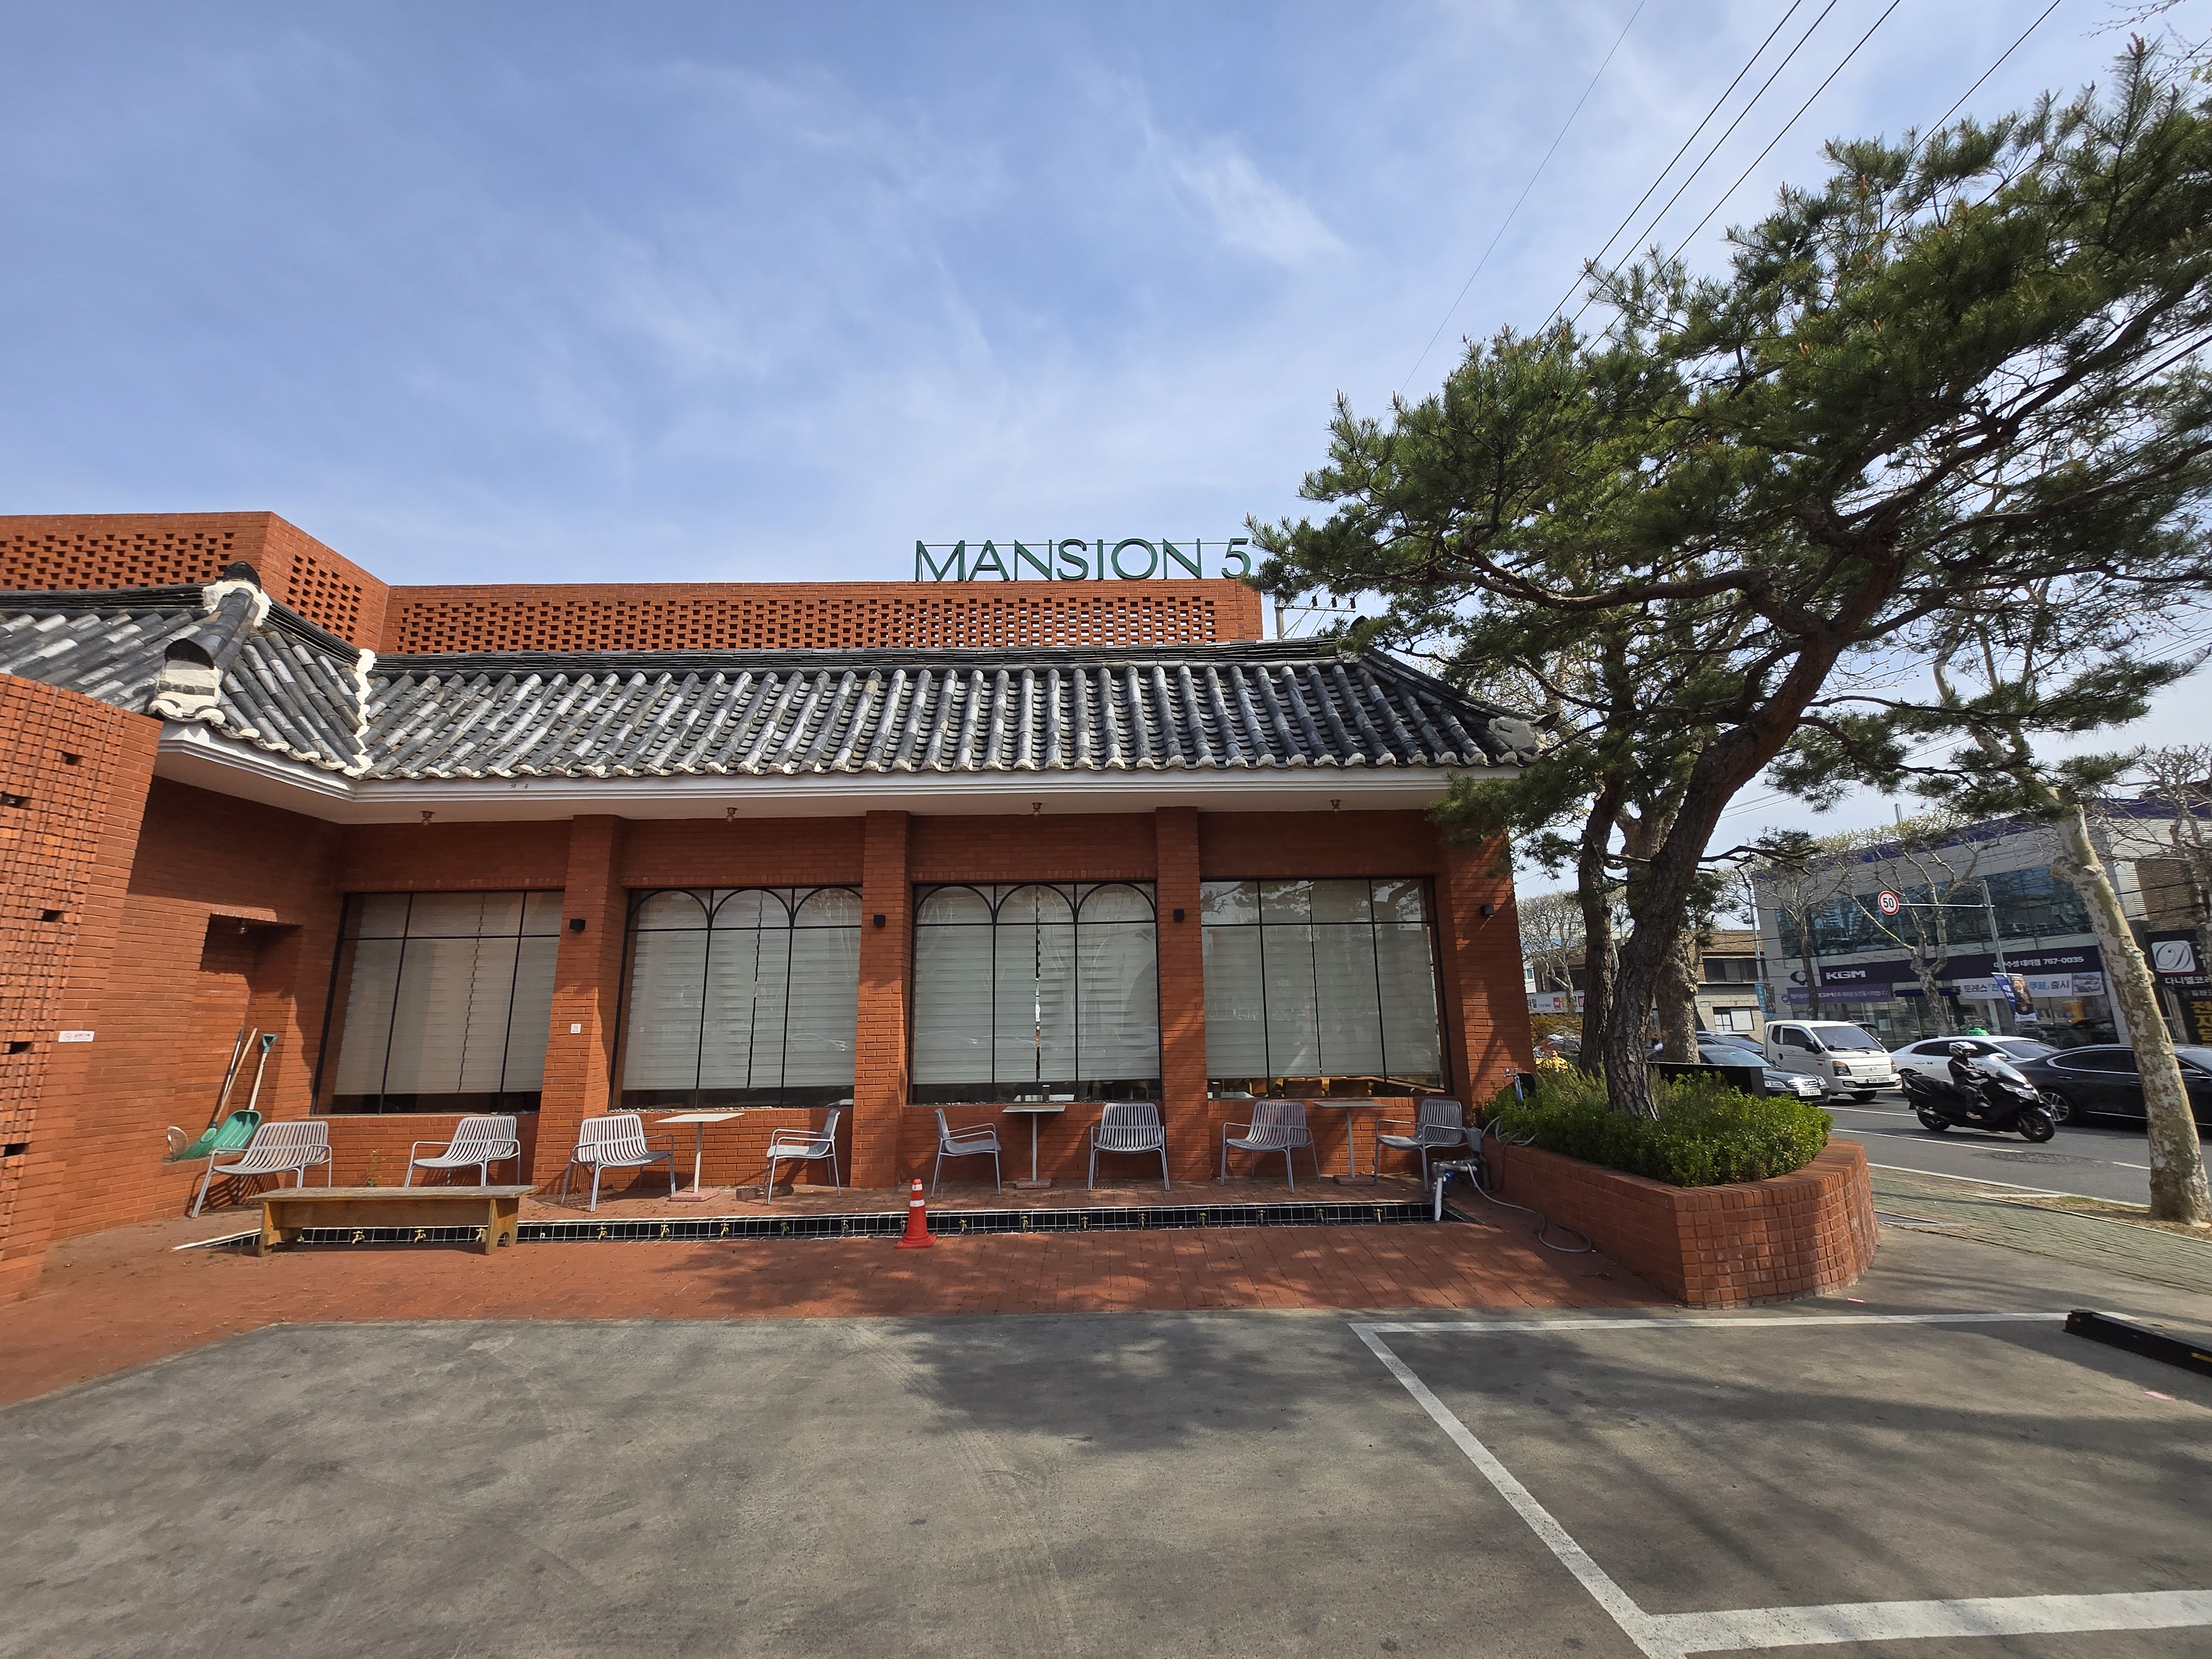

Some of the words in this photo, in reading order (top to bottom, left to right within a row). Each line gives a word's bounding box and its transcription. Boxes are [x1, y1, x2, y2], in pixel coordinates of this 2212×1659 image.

[916, 538, 1202, 581] MANSION
[1221, 538, 1252, 579] 5
[1883, 898, 1894, 908] 50
[2043, 956, 2084, 965] 767-0035
[1825, 970, 1866, 980] KGM
[1964, 984, 1988, 993] 토레스
[2051, 980, 2069, 989] 출시
